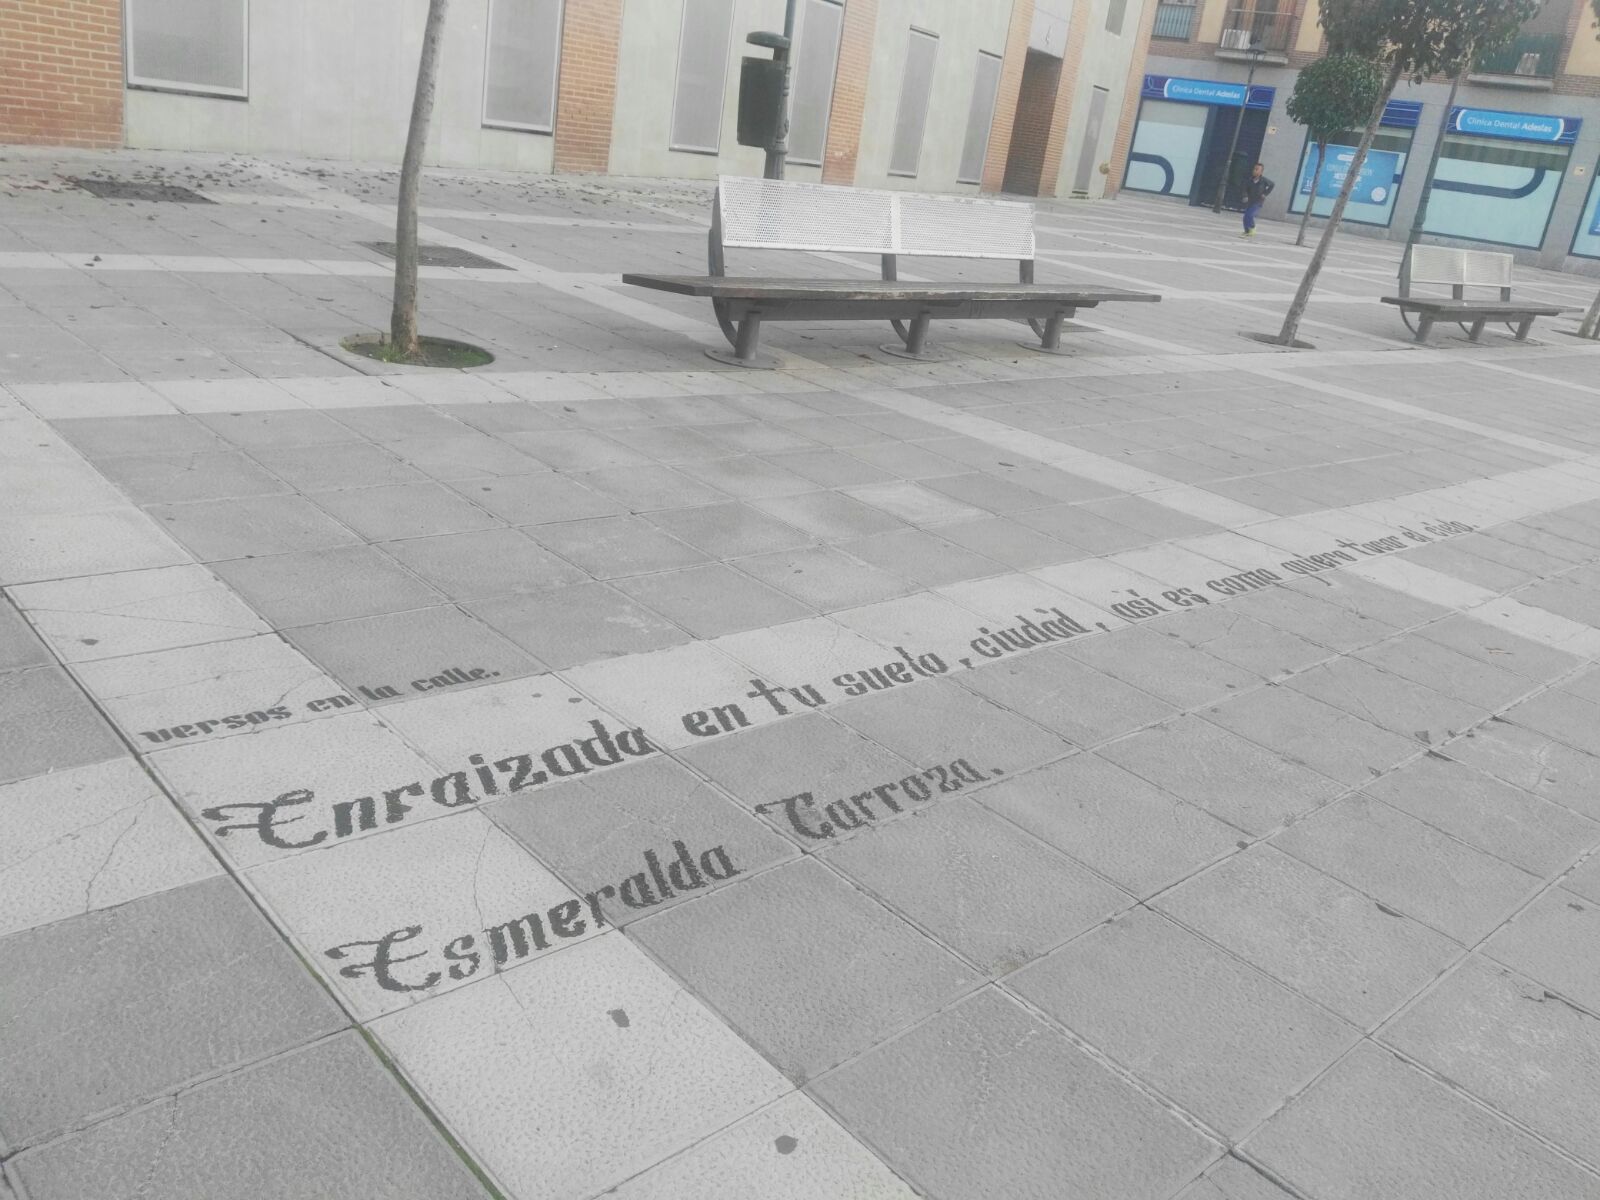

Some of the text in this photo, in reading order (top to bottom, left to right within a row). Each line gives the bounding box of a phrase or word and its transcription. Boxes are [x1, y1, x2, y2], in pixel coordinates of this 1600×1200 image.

[1194, 88, 1215, 97] Dental
[1494, 119, 1520, 129] Dental
[1521, 122, 1553, 133] Adeslas
[138, 665, 500, 744] versos en la calle.
[201, 719, 658, 849] Enraizada
[681, 703, 751, 737] en
[746, 678, 827, 715] tu
[1161, 587, 1210, 605] es
[1206, 568, 1282, 596] como
[1281, 550, 1358, 587] quiero
[1399, 525, 1434, 543] el
[324, 840, 745, 992] Esmeralda
